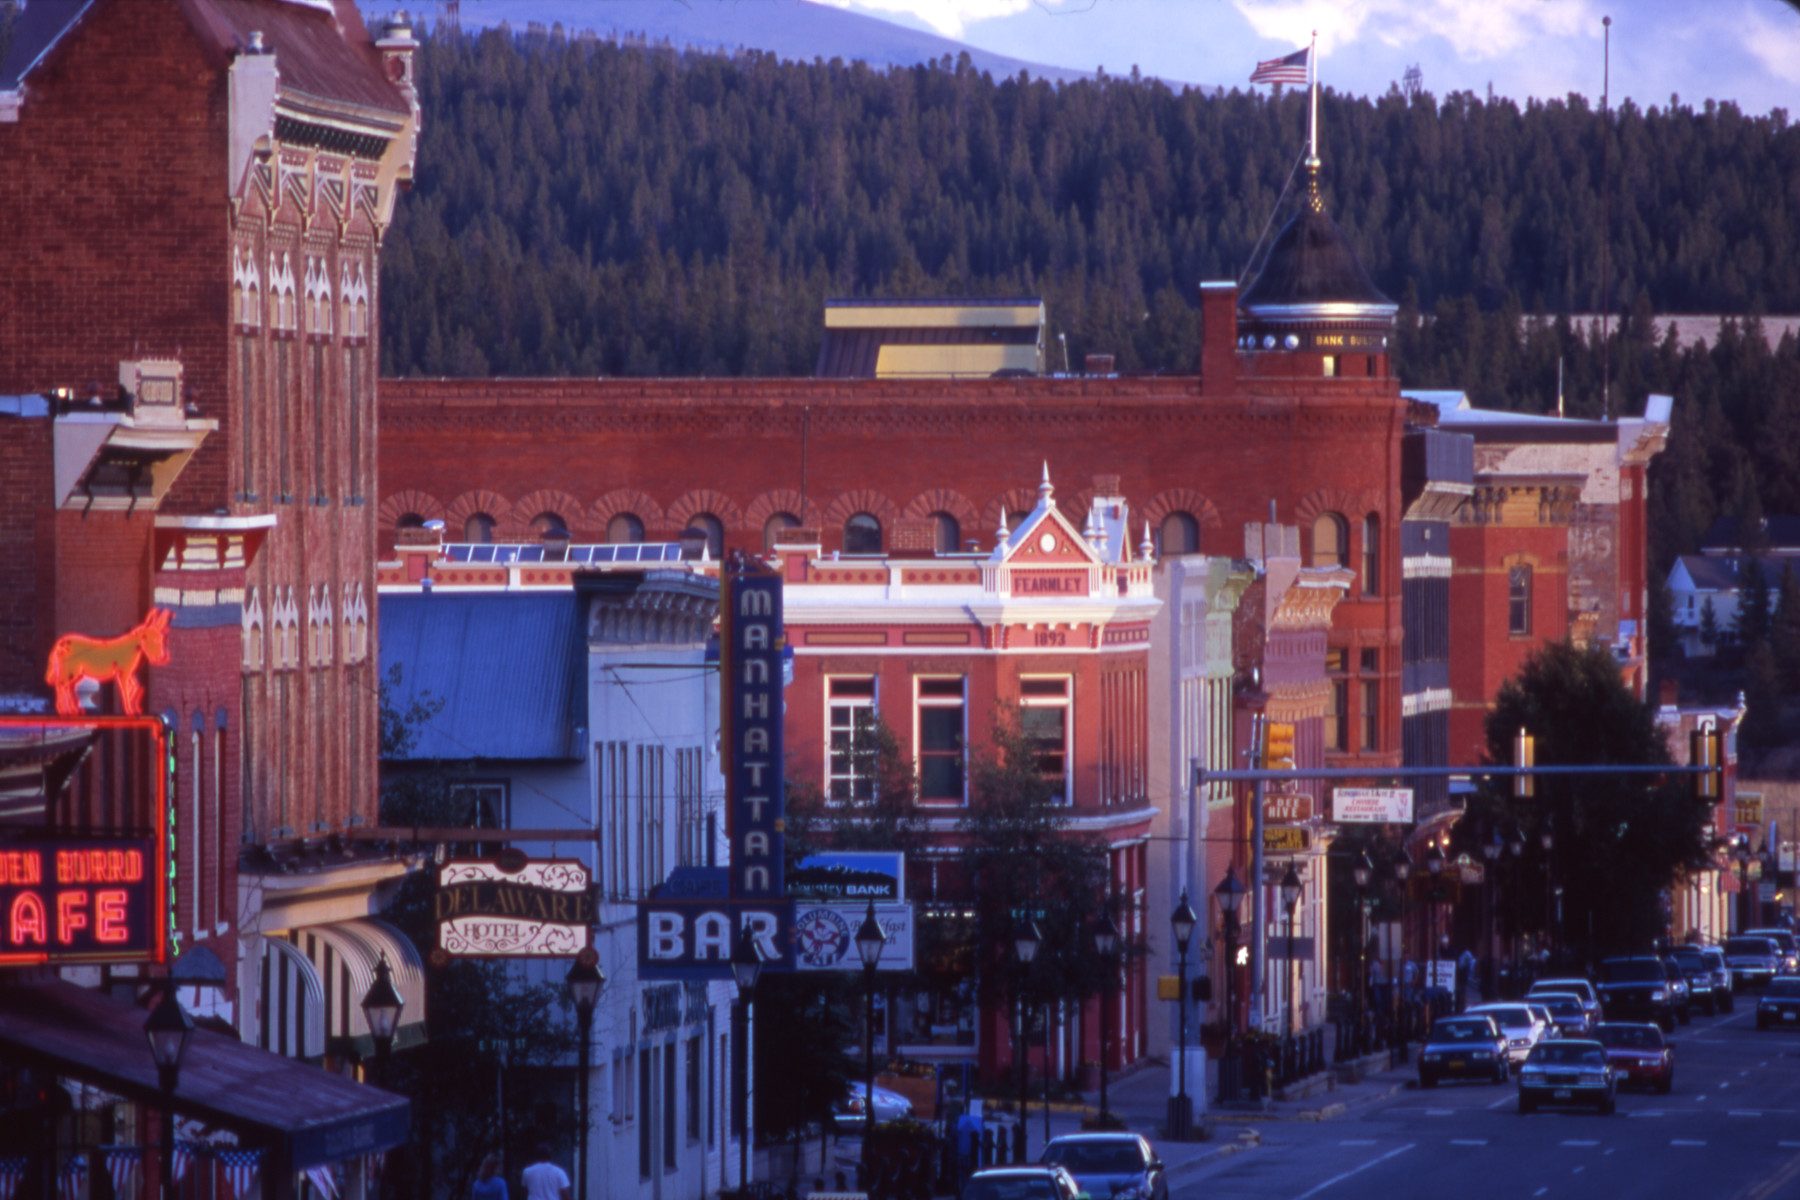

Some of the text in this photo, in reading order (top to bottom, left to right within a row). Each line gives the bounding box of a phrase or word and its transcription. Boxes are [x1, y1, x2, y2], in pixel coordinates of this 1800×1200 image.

[1315, 335, 1344, 347] BANK
[1014, 577, 1082, 593] FEARNLEY
[1034, 631, 1066, 647] 1893
[1276, 798, 1300, 808] BEE
[1268, 806, 1299, 818] HIVE
[57, 850, 142, 884] BURRO
[846, 883, 890, 895] BANK
[435, 886, 592, 921] DELAWARE
[0, 889, 128, 946] AFE
[463, 923, 527, 938] HOTEL
[648, 911, 783, 960] BAR
